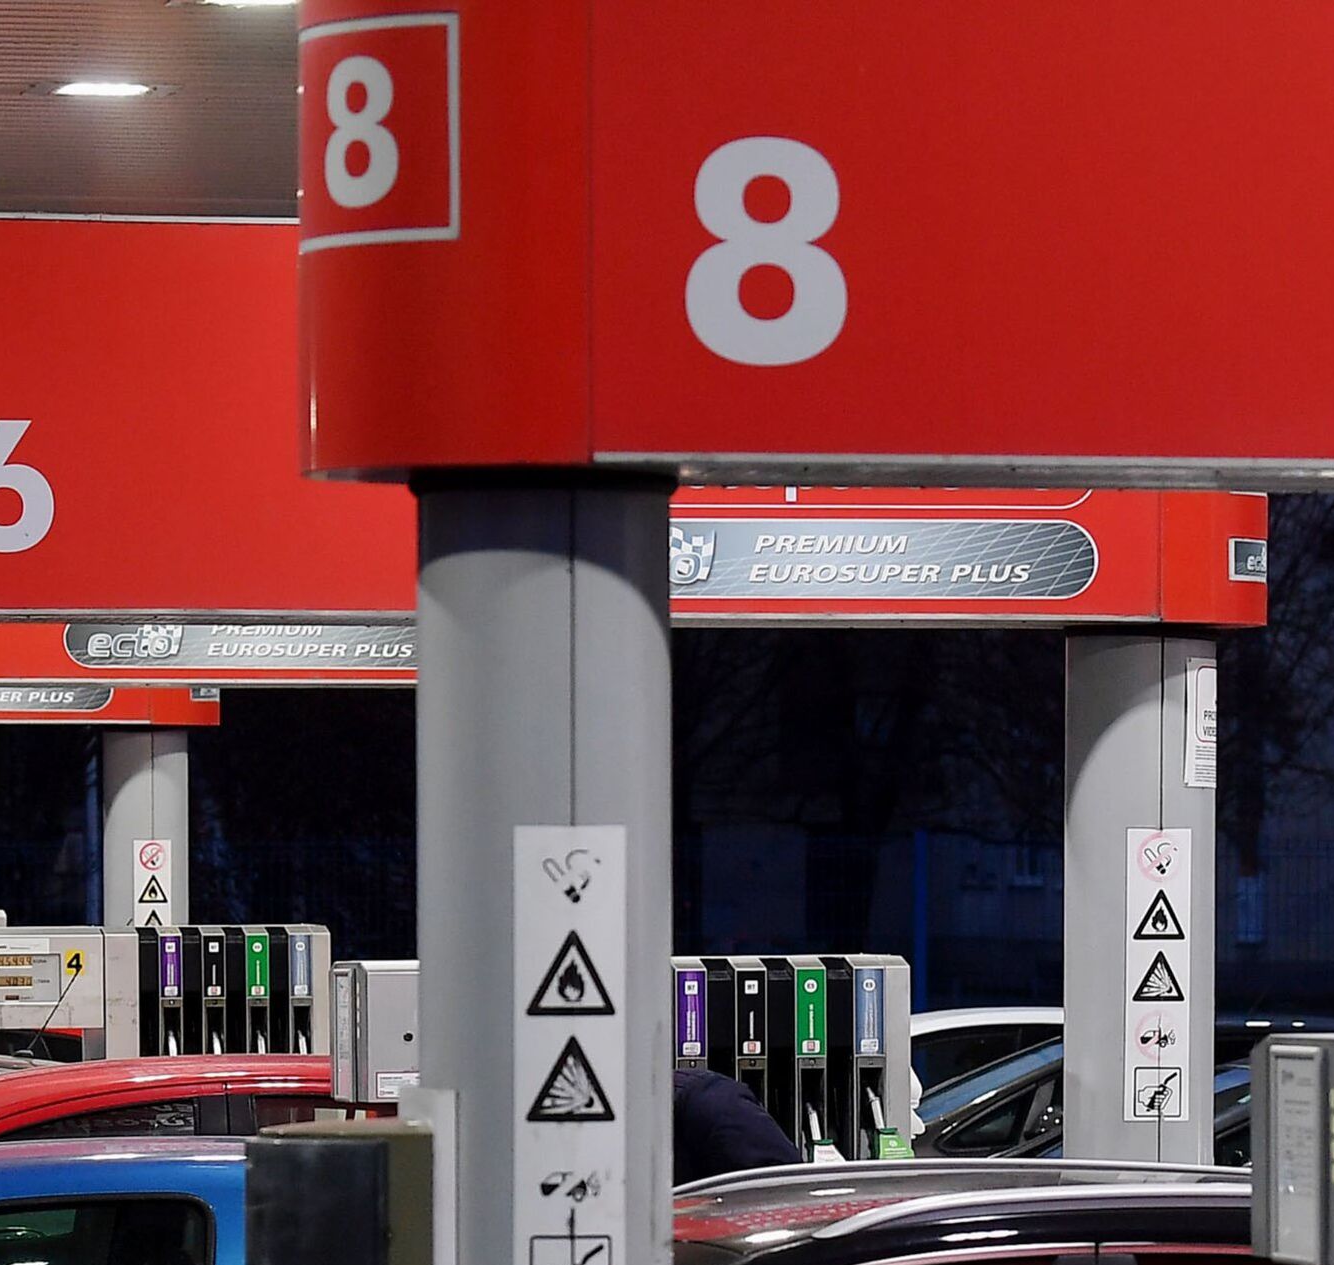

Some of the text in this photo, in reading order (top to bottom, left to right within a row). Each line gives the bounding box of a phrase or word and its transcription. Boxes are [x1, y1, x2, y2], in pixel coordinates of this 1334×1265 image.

[325, 56, 398, 208] 8
[685, 136, 847, 366] 8
[753, 533, 909, 555] PREMIUM
[748, 563, 1032, 584] EUROSUPER PLUS
[88, 627, 175, 658] ecto
[207, 642, 413, 658] EUROSUPER PLUS
[27, 691, 75, 704] PLUS
[66, 952, 83, 970] 4
